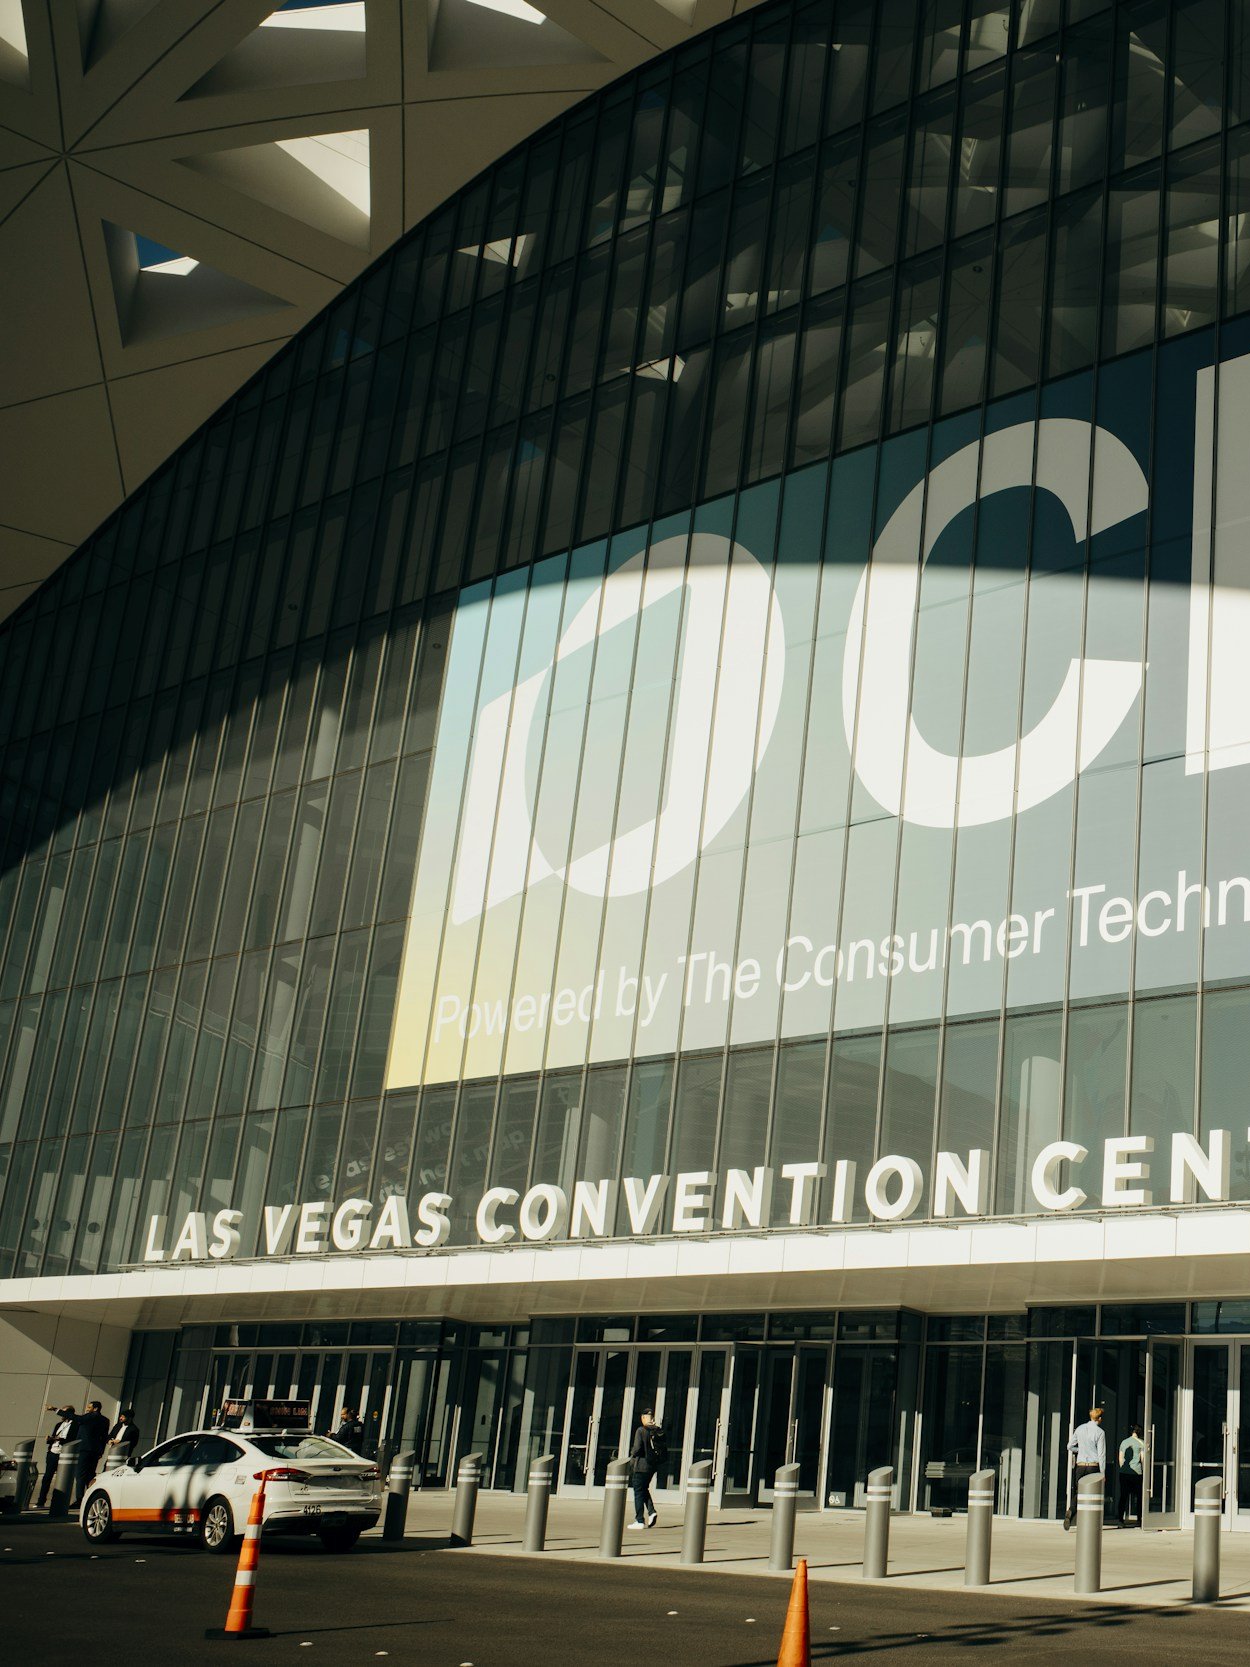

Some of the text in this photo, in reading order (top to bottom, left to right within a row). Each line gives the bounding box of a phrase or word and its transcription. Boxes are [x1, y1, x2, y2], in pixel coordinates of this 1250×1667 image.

[433, 969, 602, 1043] Powered
[615, 963, 667, 1027] by
[677, 947, 762, 1007] The
[775, 905, 1054, 991] Consumer
[143, 1208, 244, 1262] LAS
[264, 1191, 453, 1256] VEGAS
[476, 1148, 990, 1244] CONVENTION
[303, 1505, 322, 1516] 4126
